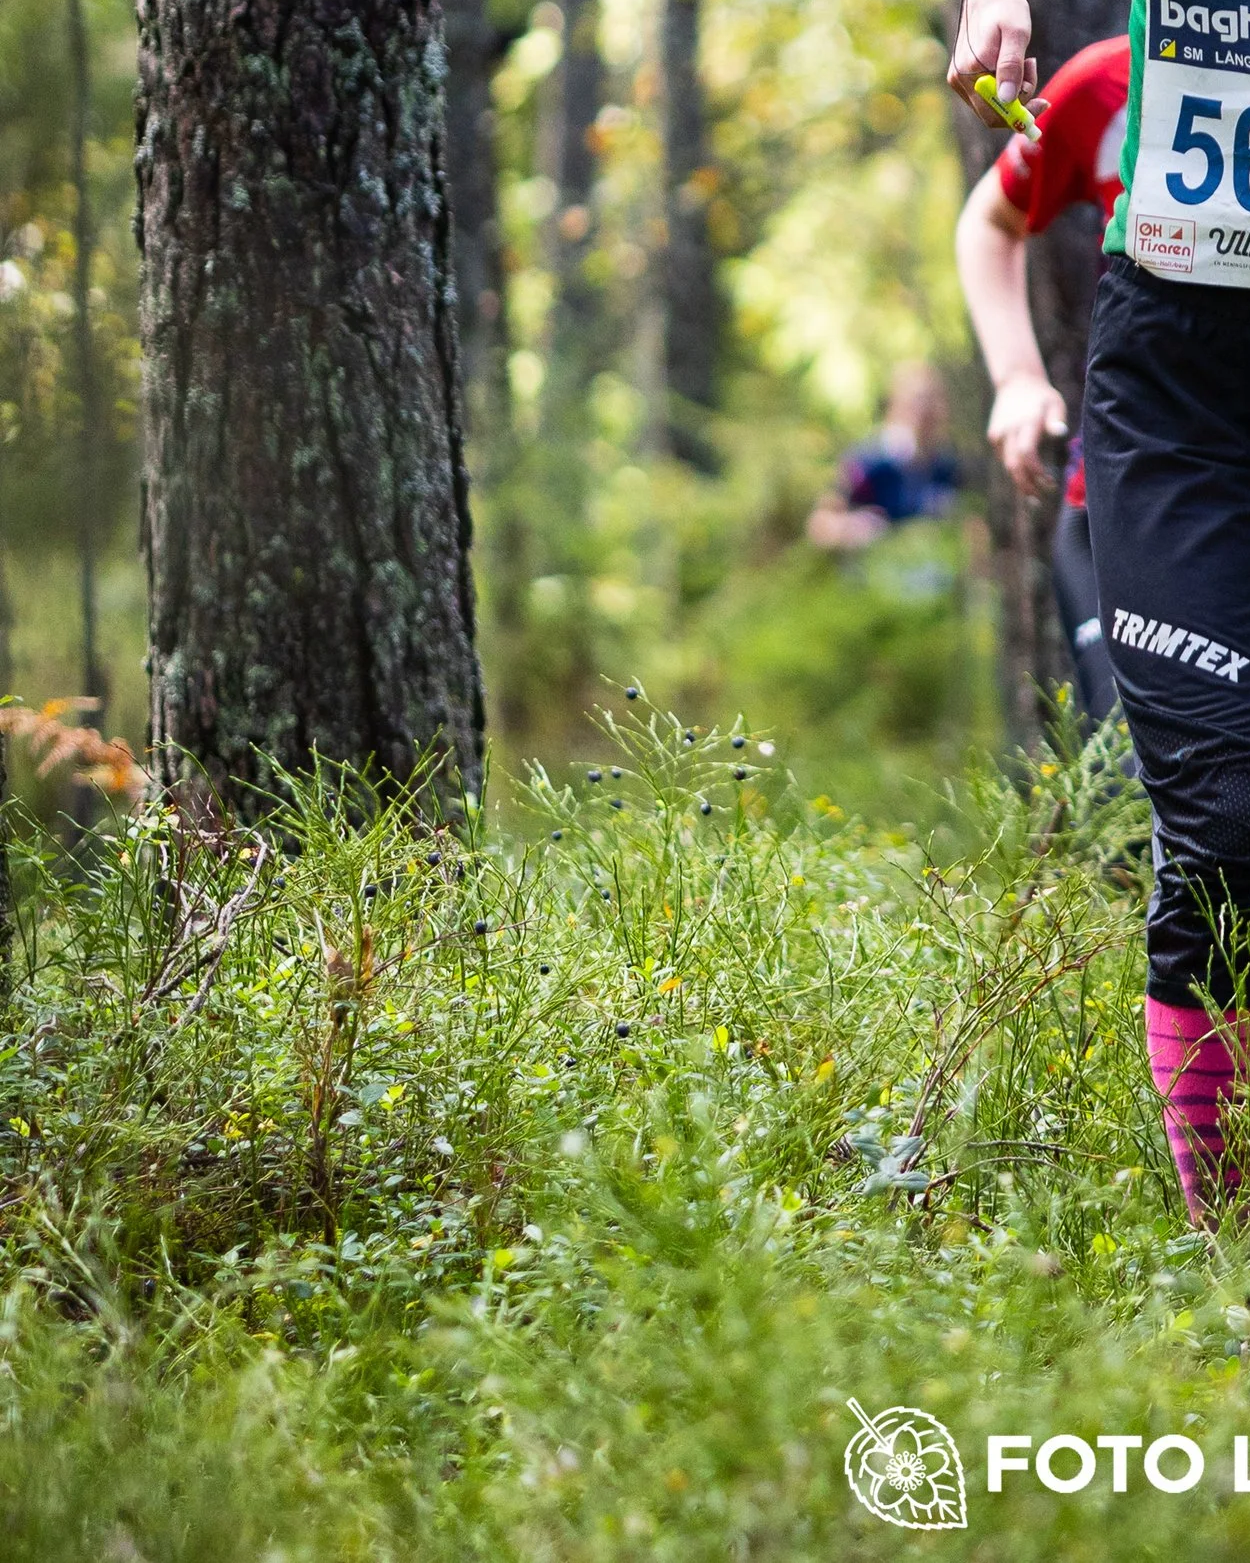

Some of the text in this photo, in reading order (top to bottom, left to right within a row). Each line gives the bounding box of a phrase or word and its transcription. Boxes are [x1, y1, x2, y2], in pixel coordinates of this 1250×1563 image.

[1183, 46, 1204, 62] SM
[1138, 238, 1191, 257] Tisaren
[1112, 608, 1250, 683] TRIMTEX
